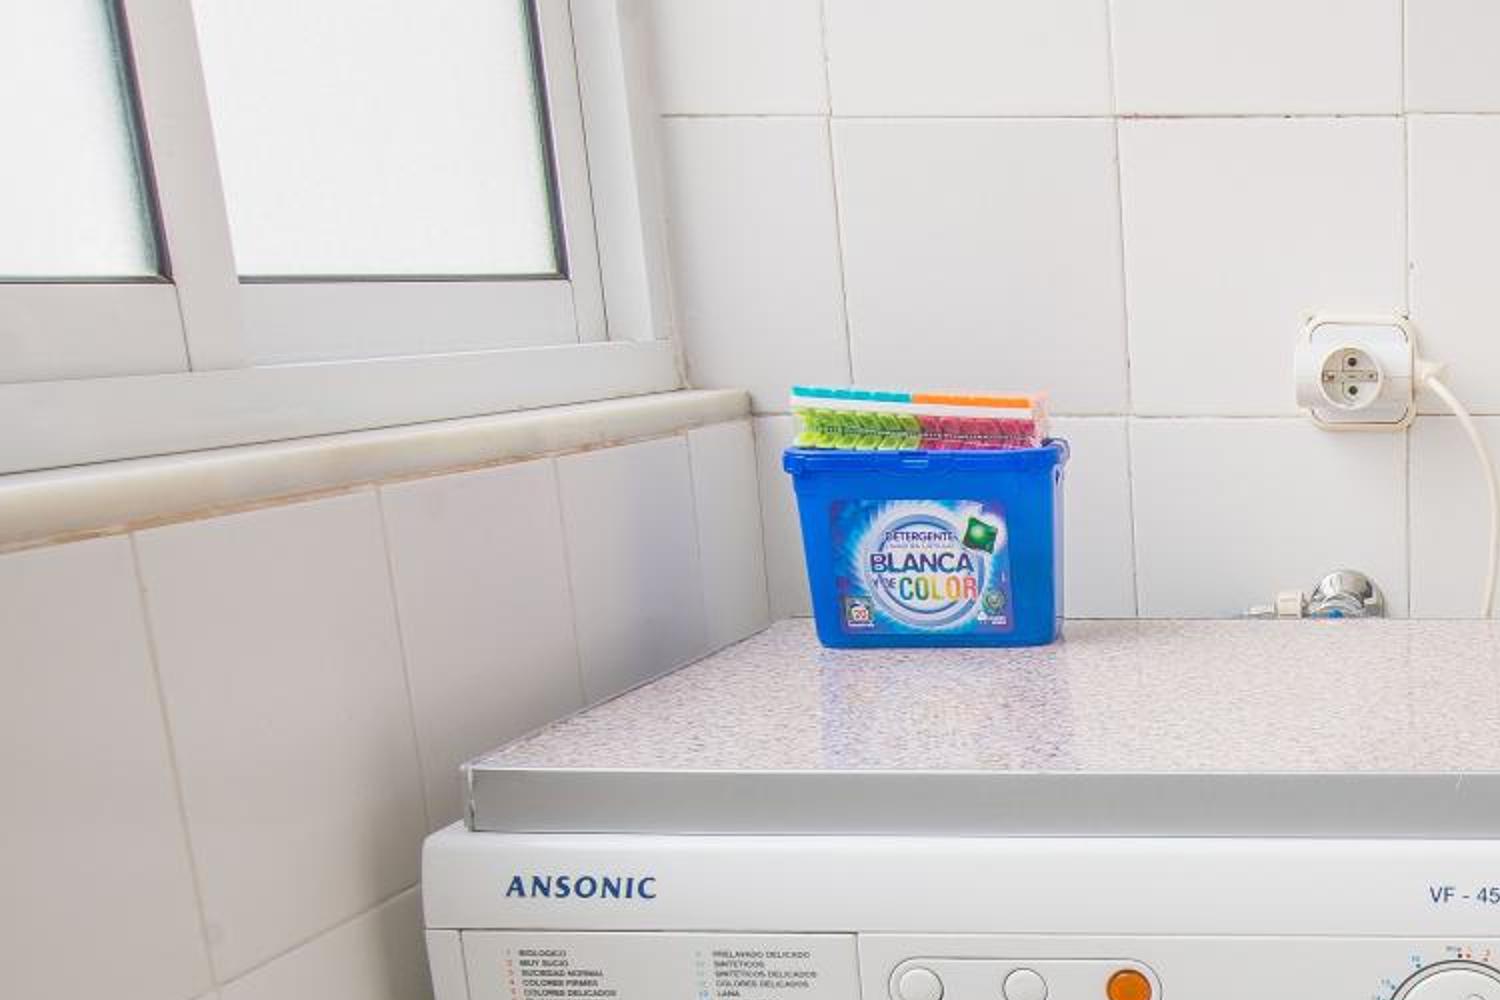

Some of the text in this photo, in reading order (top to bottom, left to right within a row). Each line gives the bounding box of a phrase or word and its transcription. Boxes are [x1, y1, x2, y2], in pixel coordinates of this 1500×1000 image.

[870, 552, 975, 573] BLANCA
[899, 575, 977, 601] COLOR
[505, 875, 657, 899] ANSONIC
[1429, 886, 1456, 904] VF
